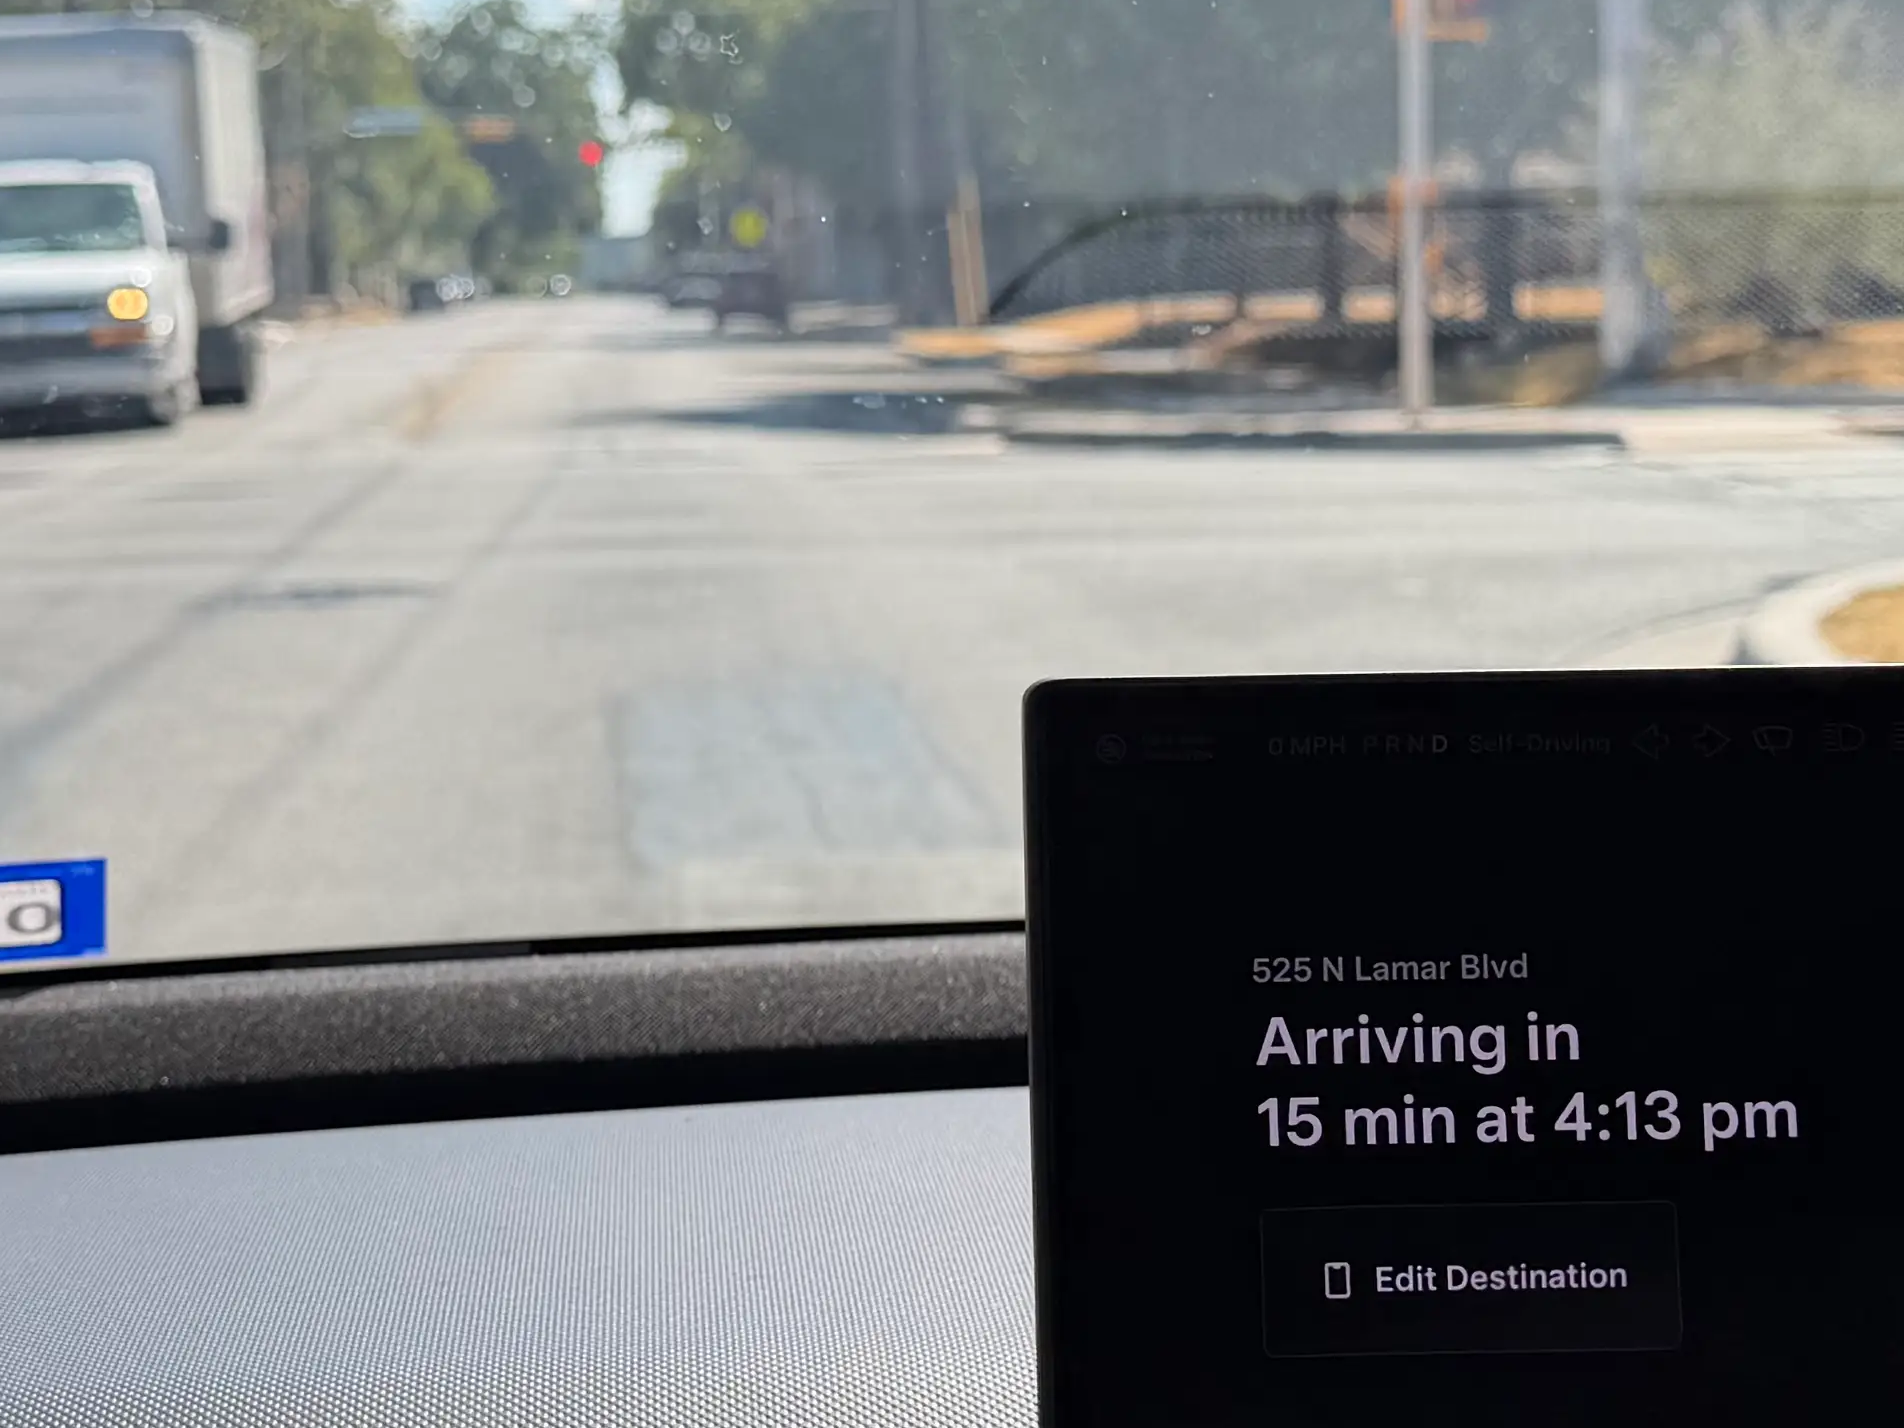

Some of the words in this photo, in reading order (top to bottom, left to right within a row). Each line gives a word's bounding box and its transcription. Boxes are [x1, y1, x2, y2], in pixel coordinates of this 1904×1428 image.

[1288, 734, 1348, 756] MPH
[1252, 957, 1312, 983] 525
[1322, 956, 1344, 982] N
[1355, 956, 1451, 982] Lamar
[1461, 952, 1528, 980] Blvd
[1255, 1012, 1506, 1075] Arriving
[1526, 1010, 1580, 1061] in
[1257, 1096, 1323, 1147] 15
[1344, 1093, 1456, 1146] min
[1476, 1096, 1535, 1143] at
[1554, 1089, 1681, 1142] 4:13
[1702, 1099, 1798, 1152] pm
[1375, 1265, 1437, 1293] Edit
[1446, 1261, 1627, 1291] Destination
